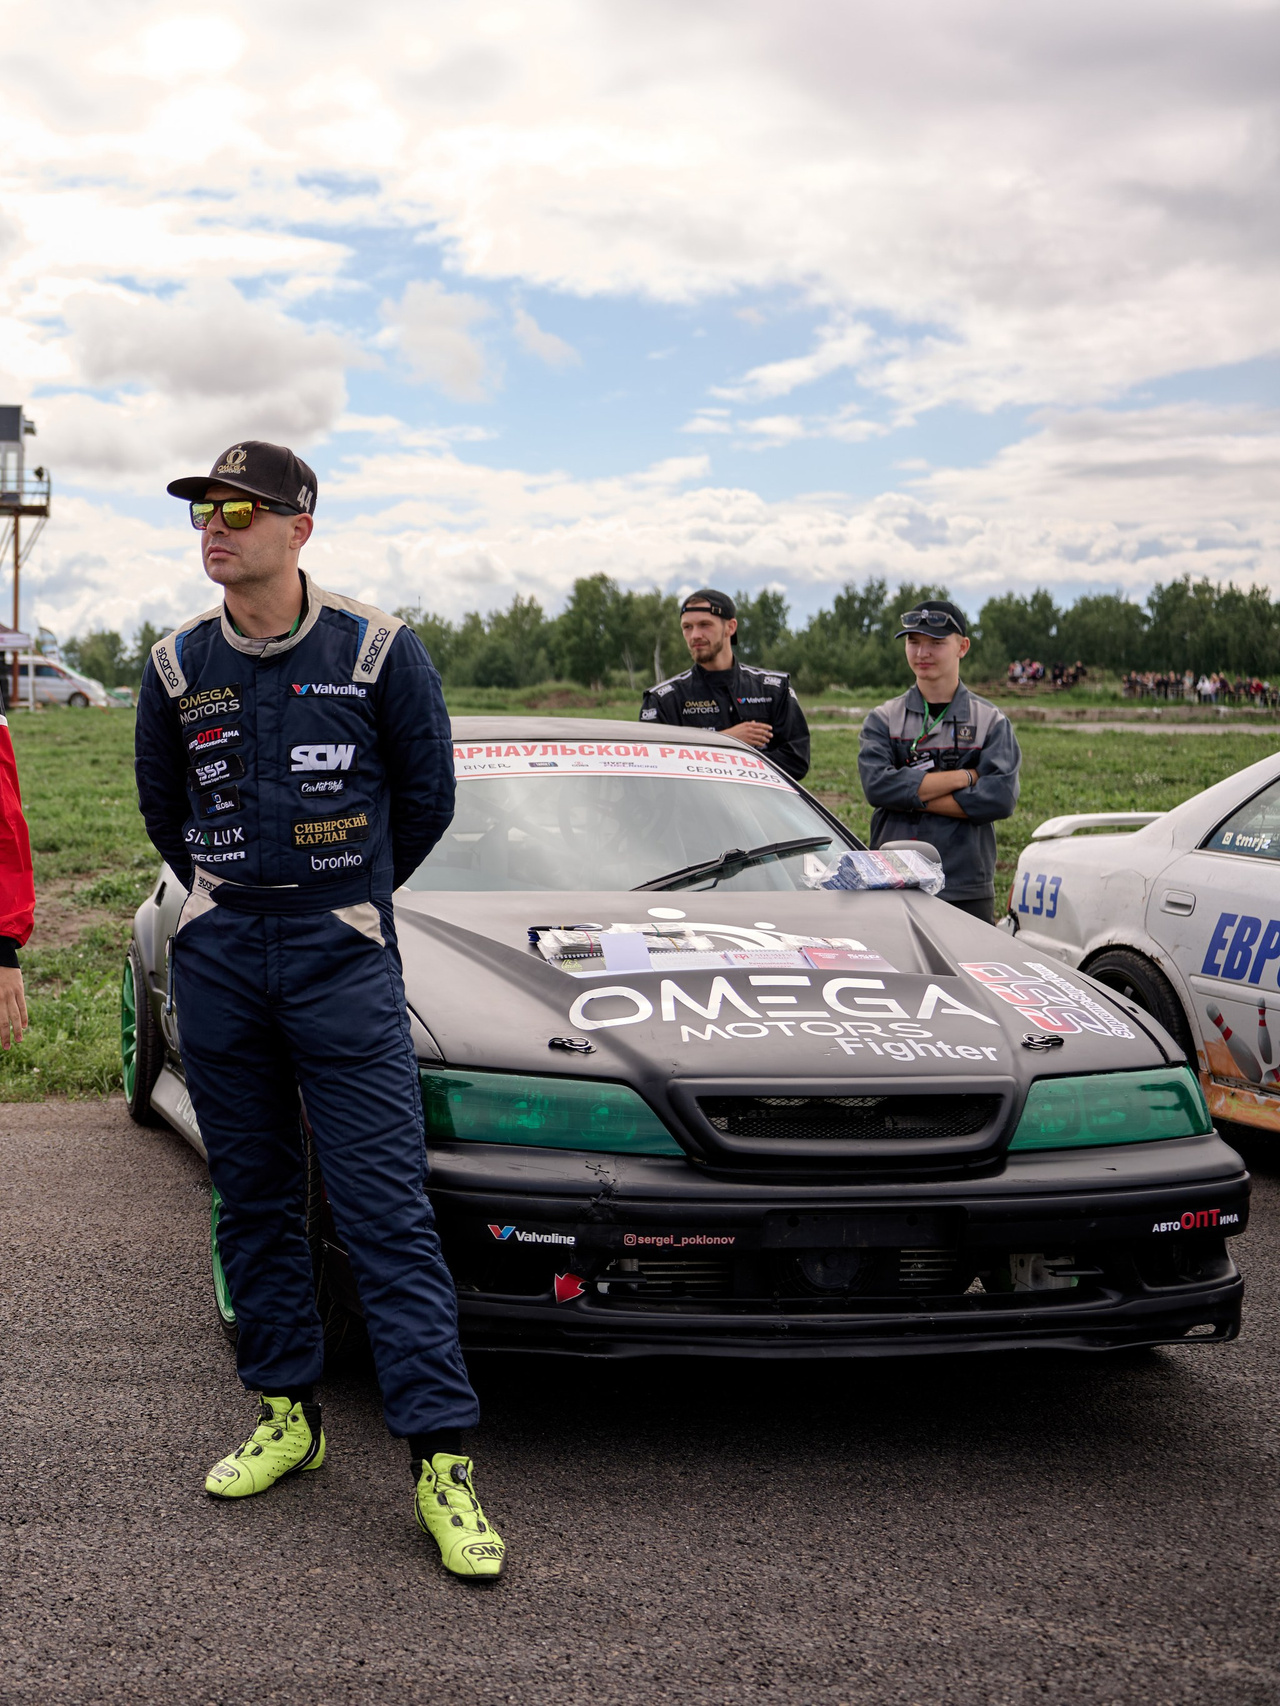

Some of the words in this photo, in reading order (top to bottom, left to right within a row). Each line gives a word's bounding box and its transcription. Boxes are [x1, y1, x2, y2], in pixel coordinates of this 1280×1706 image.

[296, 485, 313, 512] 44
[361, 627, 389, 674] sparco
[156, 646, 179, 689] sparco
[179, 687, 235, 710] OMEGA
[685, 700, 718, 708] OMEGA
[180, 699, 240, 725] MOTORS
[641, 709, 657, 719] OMP
[682, 707, 720, 715] MOTORS
[291, 744, 356, 771] SCW
[453, 743, 649, 760] АРНАУЛЬСКОЙ
[659, 747, 765, 770] РАКЕТЫ
[464, 763, 511, 771] RIVER
[196, 760, 227, 781] SSP
[686, 765, 733, 776] СЕЗОН
[737, 769, 781, 784] 2025
[294, 813, 368, 834] СИБИРСКИЙ
[295, 830, 347, 845] КАРДАН
[311, 851, 362, 871] bronko
[1018, 872, 1062, 919] 133
[1201, 912, 1280, 988] ЕВР
[568, 975, 1001, 1031] OMEGA
[958, 961, 1114, 1037] SSP
[681, 1021, 934, 1043] MOTORS
[834, 1037, 999, 1062] Fighter
[1152, 1209, 1239, 1233] АВТООПТИМА
[515, 1230, 576, 1245] Valvoline
[637, 1234, 735, 1246] sergei_poklonov
